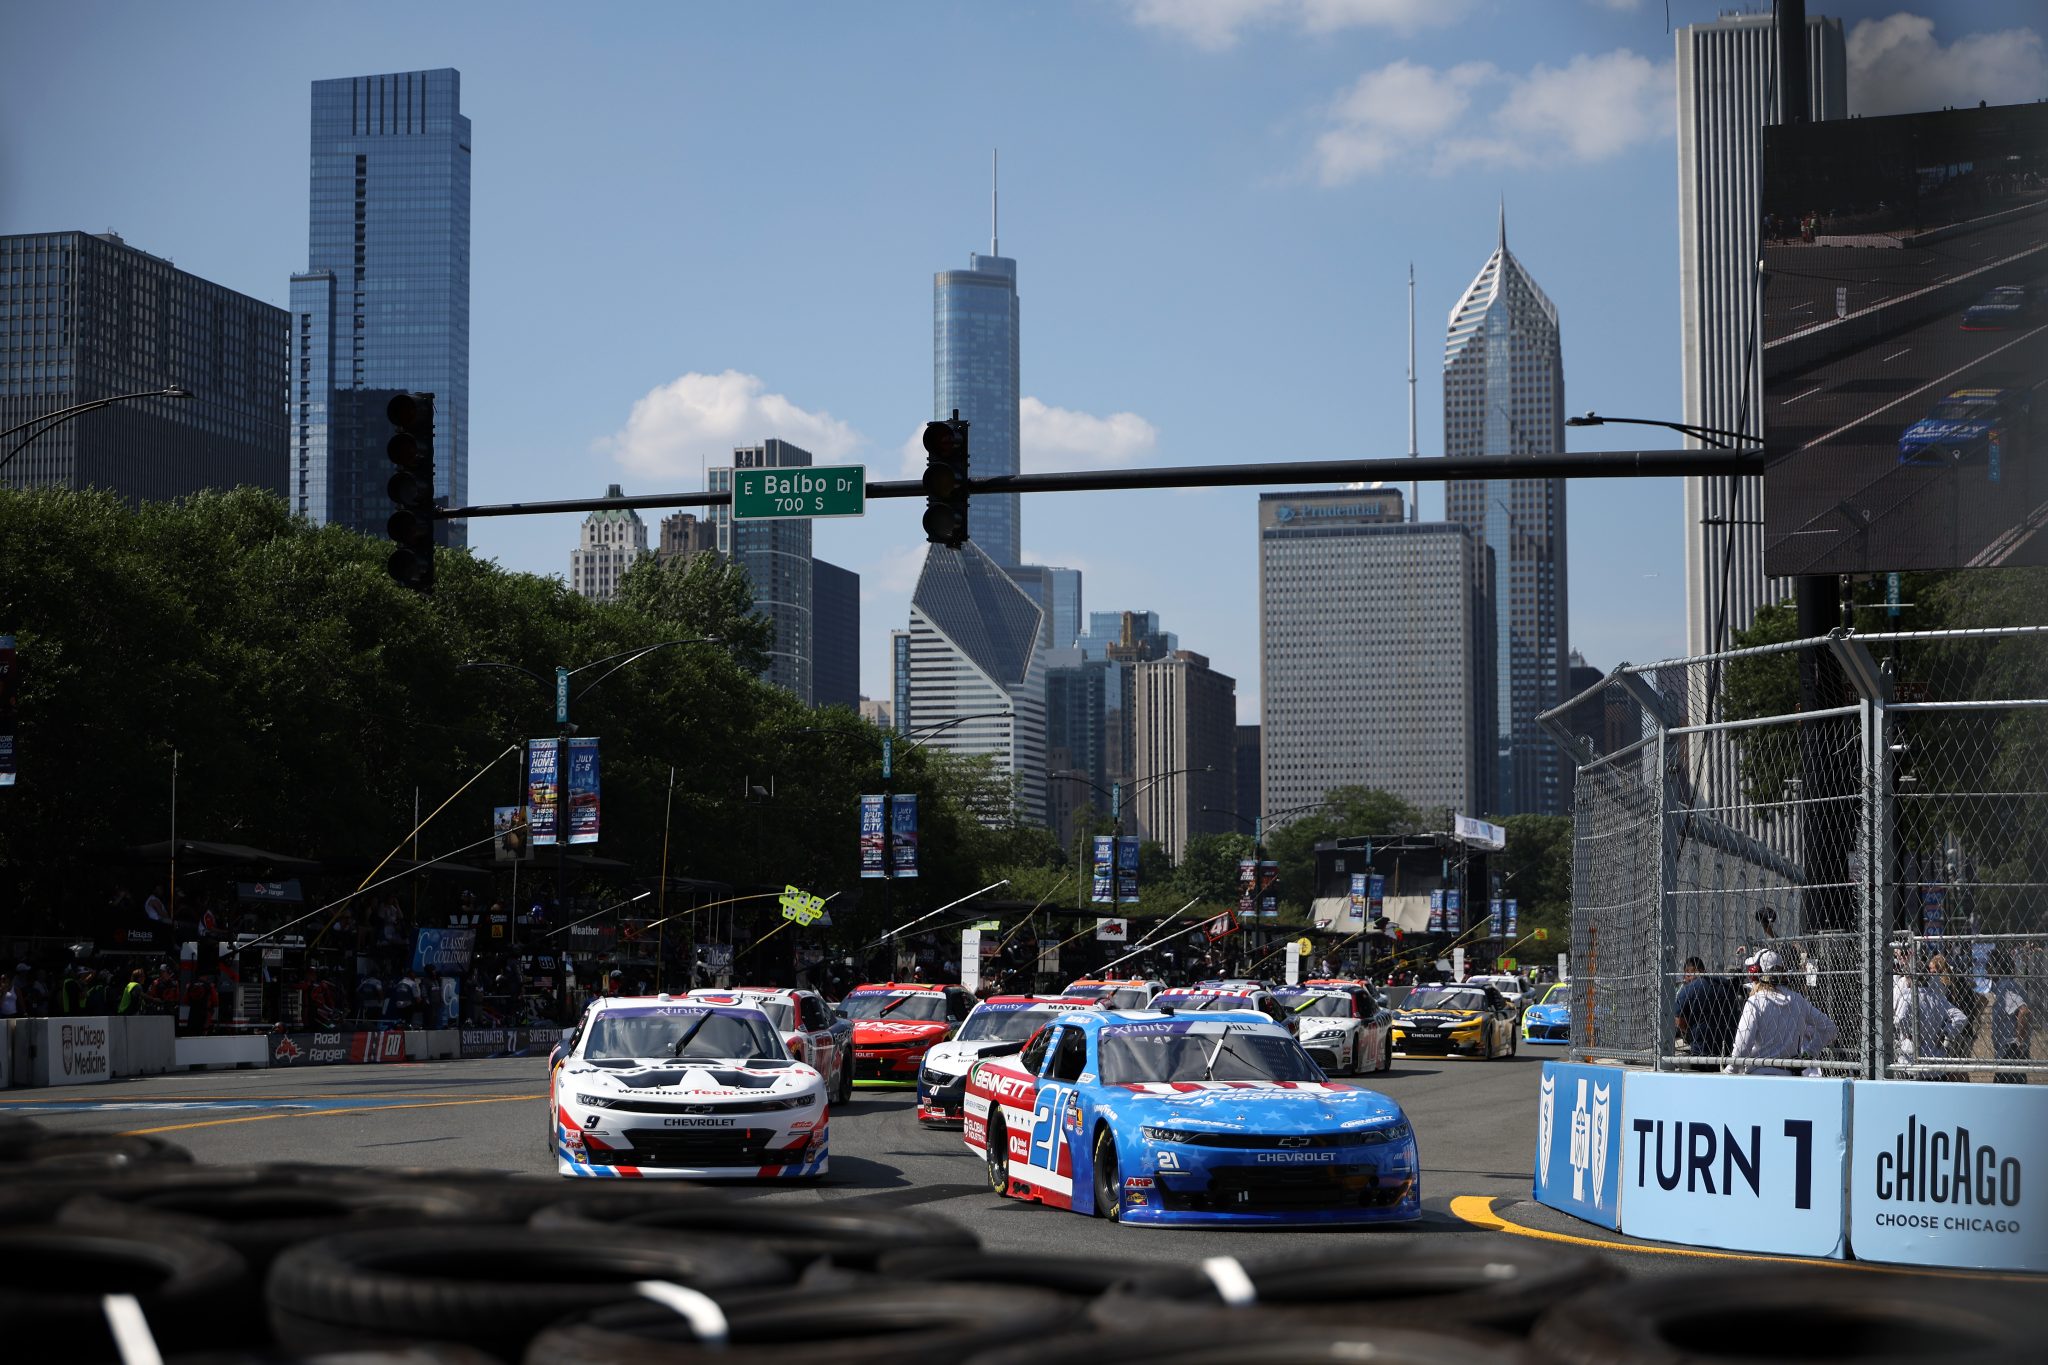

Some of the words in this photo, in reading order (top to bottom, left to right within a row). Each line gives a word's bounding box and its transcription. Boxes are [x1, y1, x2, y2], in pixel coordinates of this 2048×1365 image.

[744, 481, 753, 495] E
[764, 474, 827, 495] Balbo
[837, 478, 853, 492] Dr
[774, 498, 804, 512] 700
[815, 497, 824, 511] S
[1302, 501, 1379, 517] Prudential
[558, 675, 567, 716] C620
[531, 758, 554, 767] HOME
[576, 754, 593, 763] JULY
[863, 823, 881, 831] CITY
[1210, 915, 1229, 935] 41
[128, 930, 152, 938] Haas
[440, 937, 469, 950] CLASSIC
[433, 951, 470, 964] COLLISION
[656, 1007, 709, 1016] xfinity
[1114, 1022, 1174, 1035] xfinity
[1230, 1024, 1258, 1032] HILL
[74, 1024, 105, 1049] UChicago
[314, 1032, 340, 1045] Road
[462, 1031, 504, 1044] SWEETWATER
[507, 1032, 518, 1052] 71
[529, 1029, 563, 1043] SWEETWAT
[309, 1048, 346, 1061] Ranger
[74, 1050, 106, 1075] Medicine
[929, 1085, 940, 1096] 41
[976, 1069, 1033, 1099] BENNETT
[584, 1115, 600, 1129] 9
[664, 1119, 737, 1127] CHEVROLET
[1157, 1151, 1180, 1169] 21
[1257, 1152, 1336, 1162] CHEVROLET
[1633, 1119, 1761, 1199] TURN
[1784, 1119, 1813, 1209] 1
[1126, 1178, 1152, 1187] ARP
[1875, 1213, 1939, 1229] CHOOSE
[1943, 1217, 2020, 1233] CHICAGO
